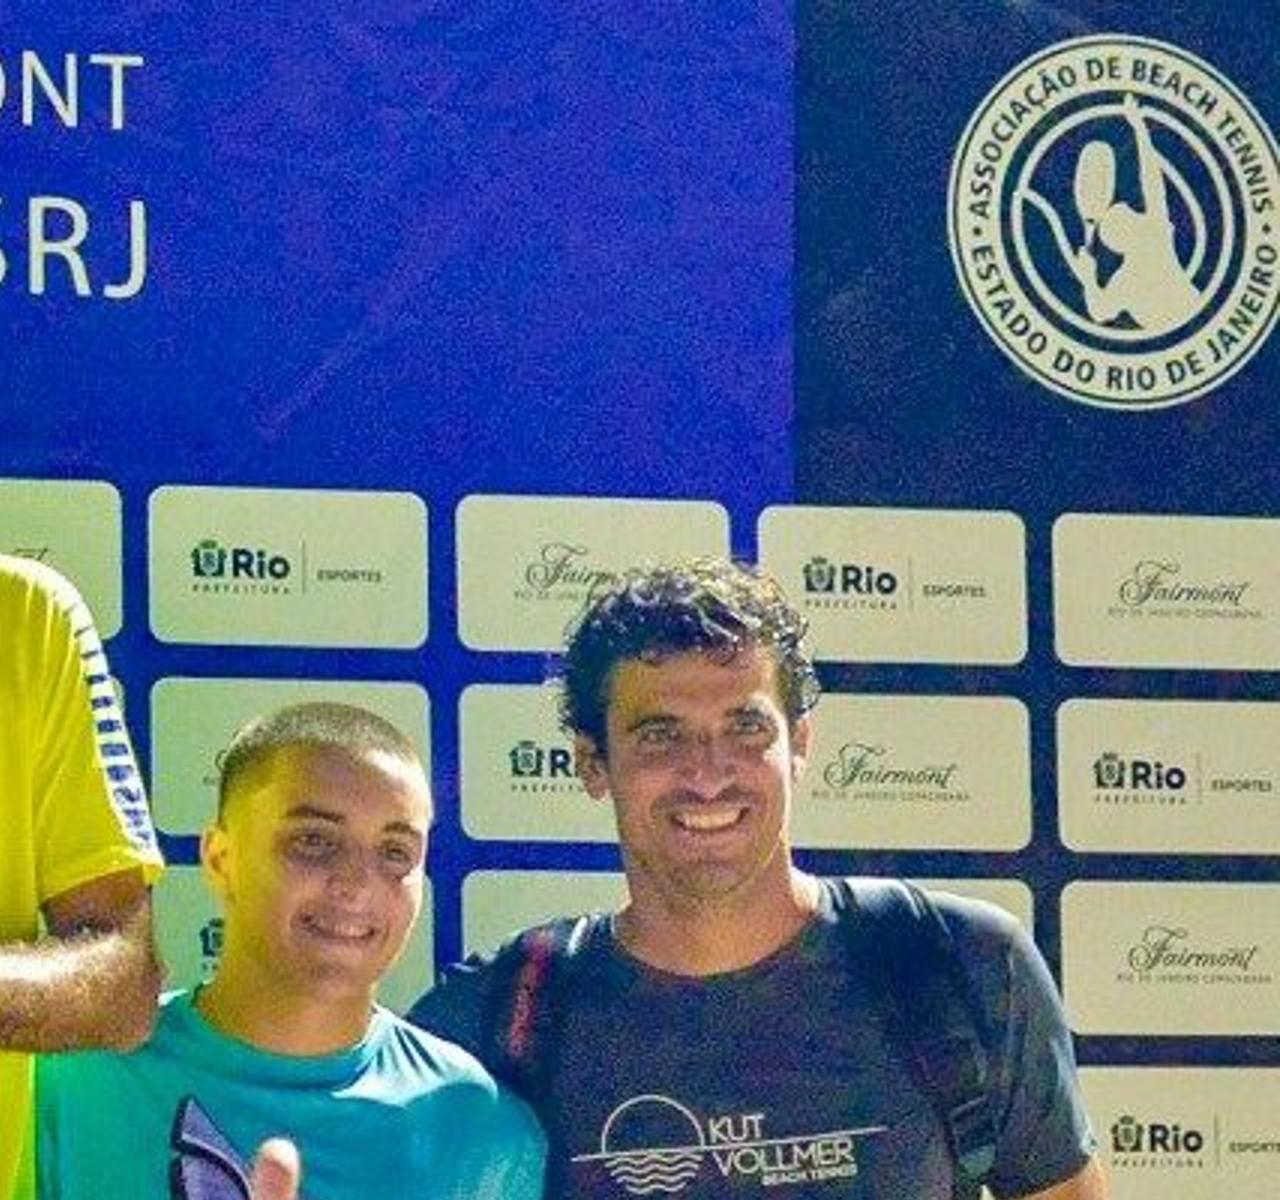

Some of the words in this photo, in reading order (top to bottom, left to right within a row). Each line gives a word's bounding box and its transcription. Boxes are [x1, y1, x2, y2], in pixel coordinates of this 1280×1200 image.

[967, 63, 1078, 220] ASSOCIAÇÃO
[1084, 56, 1123, 81] DE
[1131, 58, 1219, 118] BEACH
[1215, 110, 1273, 216] TENNIS
[971, 244, 1048, 356] ESTADO
[1051, 346, 1096, 386] DO
[1106, 364, 1156, 391] RIO
[1165, 350, 1205, 386] DE
[1208, 242, 1278, 364] JANEIRO
[232, 548, 290, 579] Rio
[840, 565, 897, 594] Rio
[1119, 560, 1252, 606] Fairmont
[823, 743, 957, 789] Fairmont
[1132, 761, 1186, 790] Rio
[1127, 926, 1258, 972] Fairmont
[708, 1113, 765, 1143] KUT
[1148, 1124, 1203, 1153] Rio
[712, 1137, 856, 1177] VOLLMER
